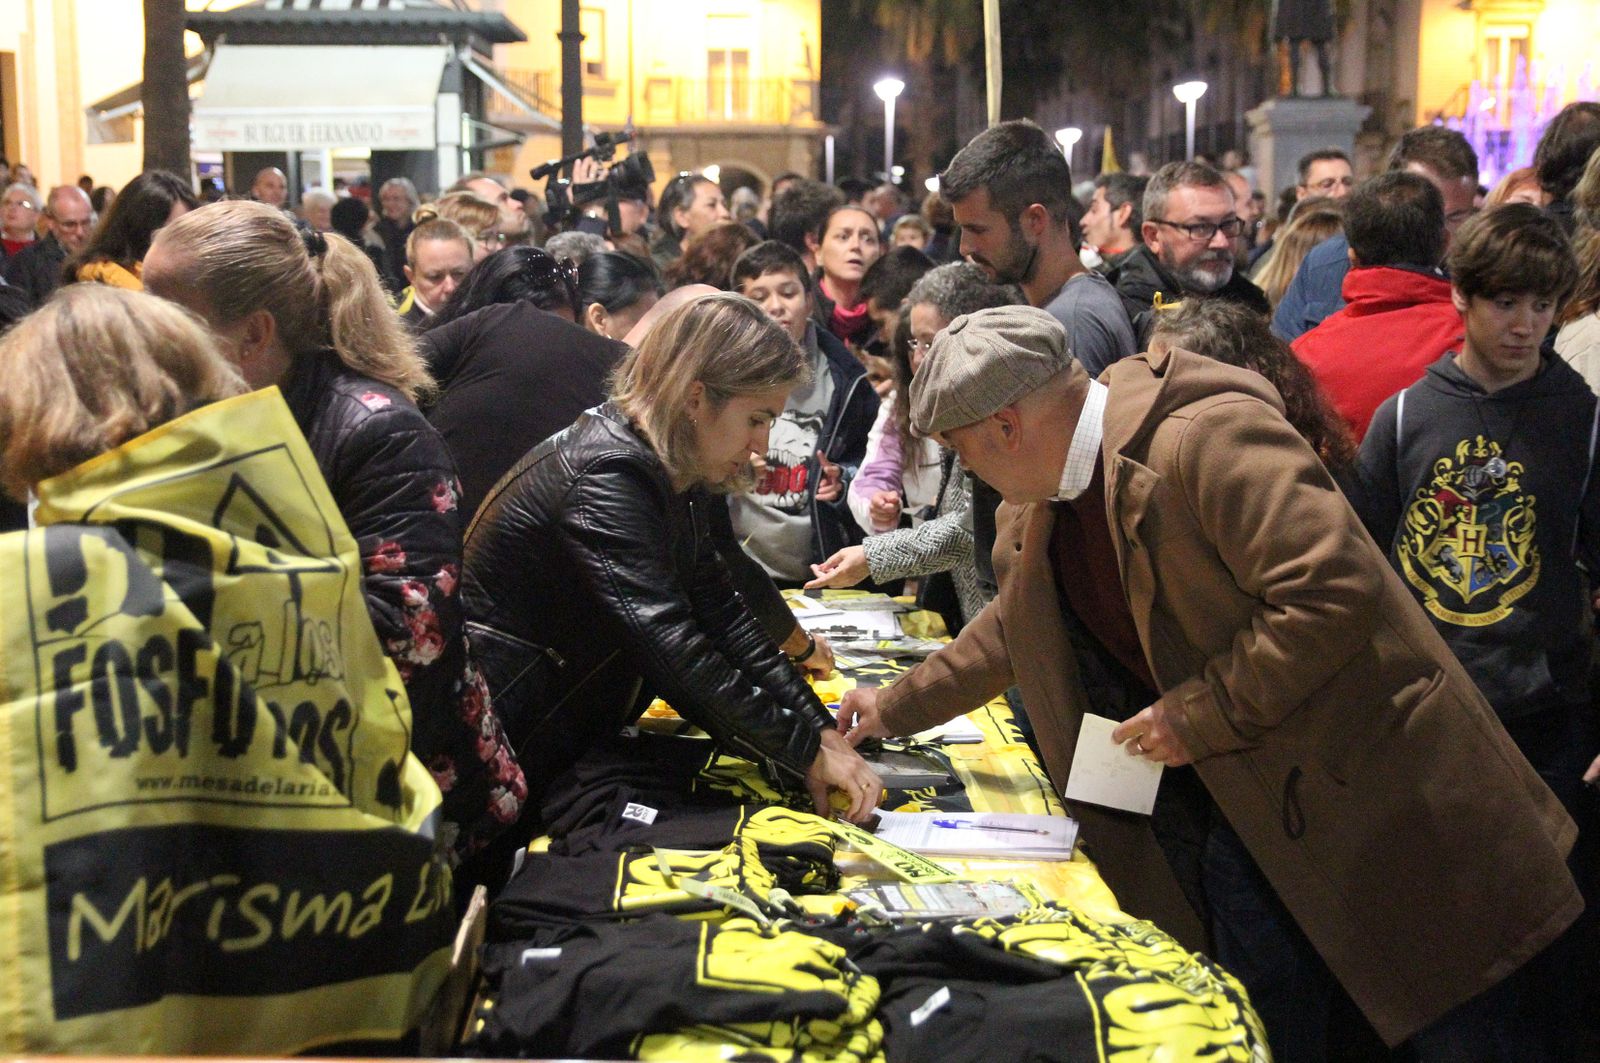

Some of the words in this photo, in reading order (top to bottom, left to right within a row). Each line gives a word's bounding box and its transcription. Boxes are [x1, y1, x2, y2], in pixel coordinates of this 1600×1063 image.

[309, 123, 384, 143] FERNANDO
[1463, 530, 1482, 553] H
[67, 873, 393, 961] Marisma
